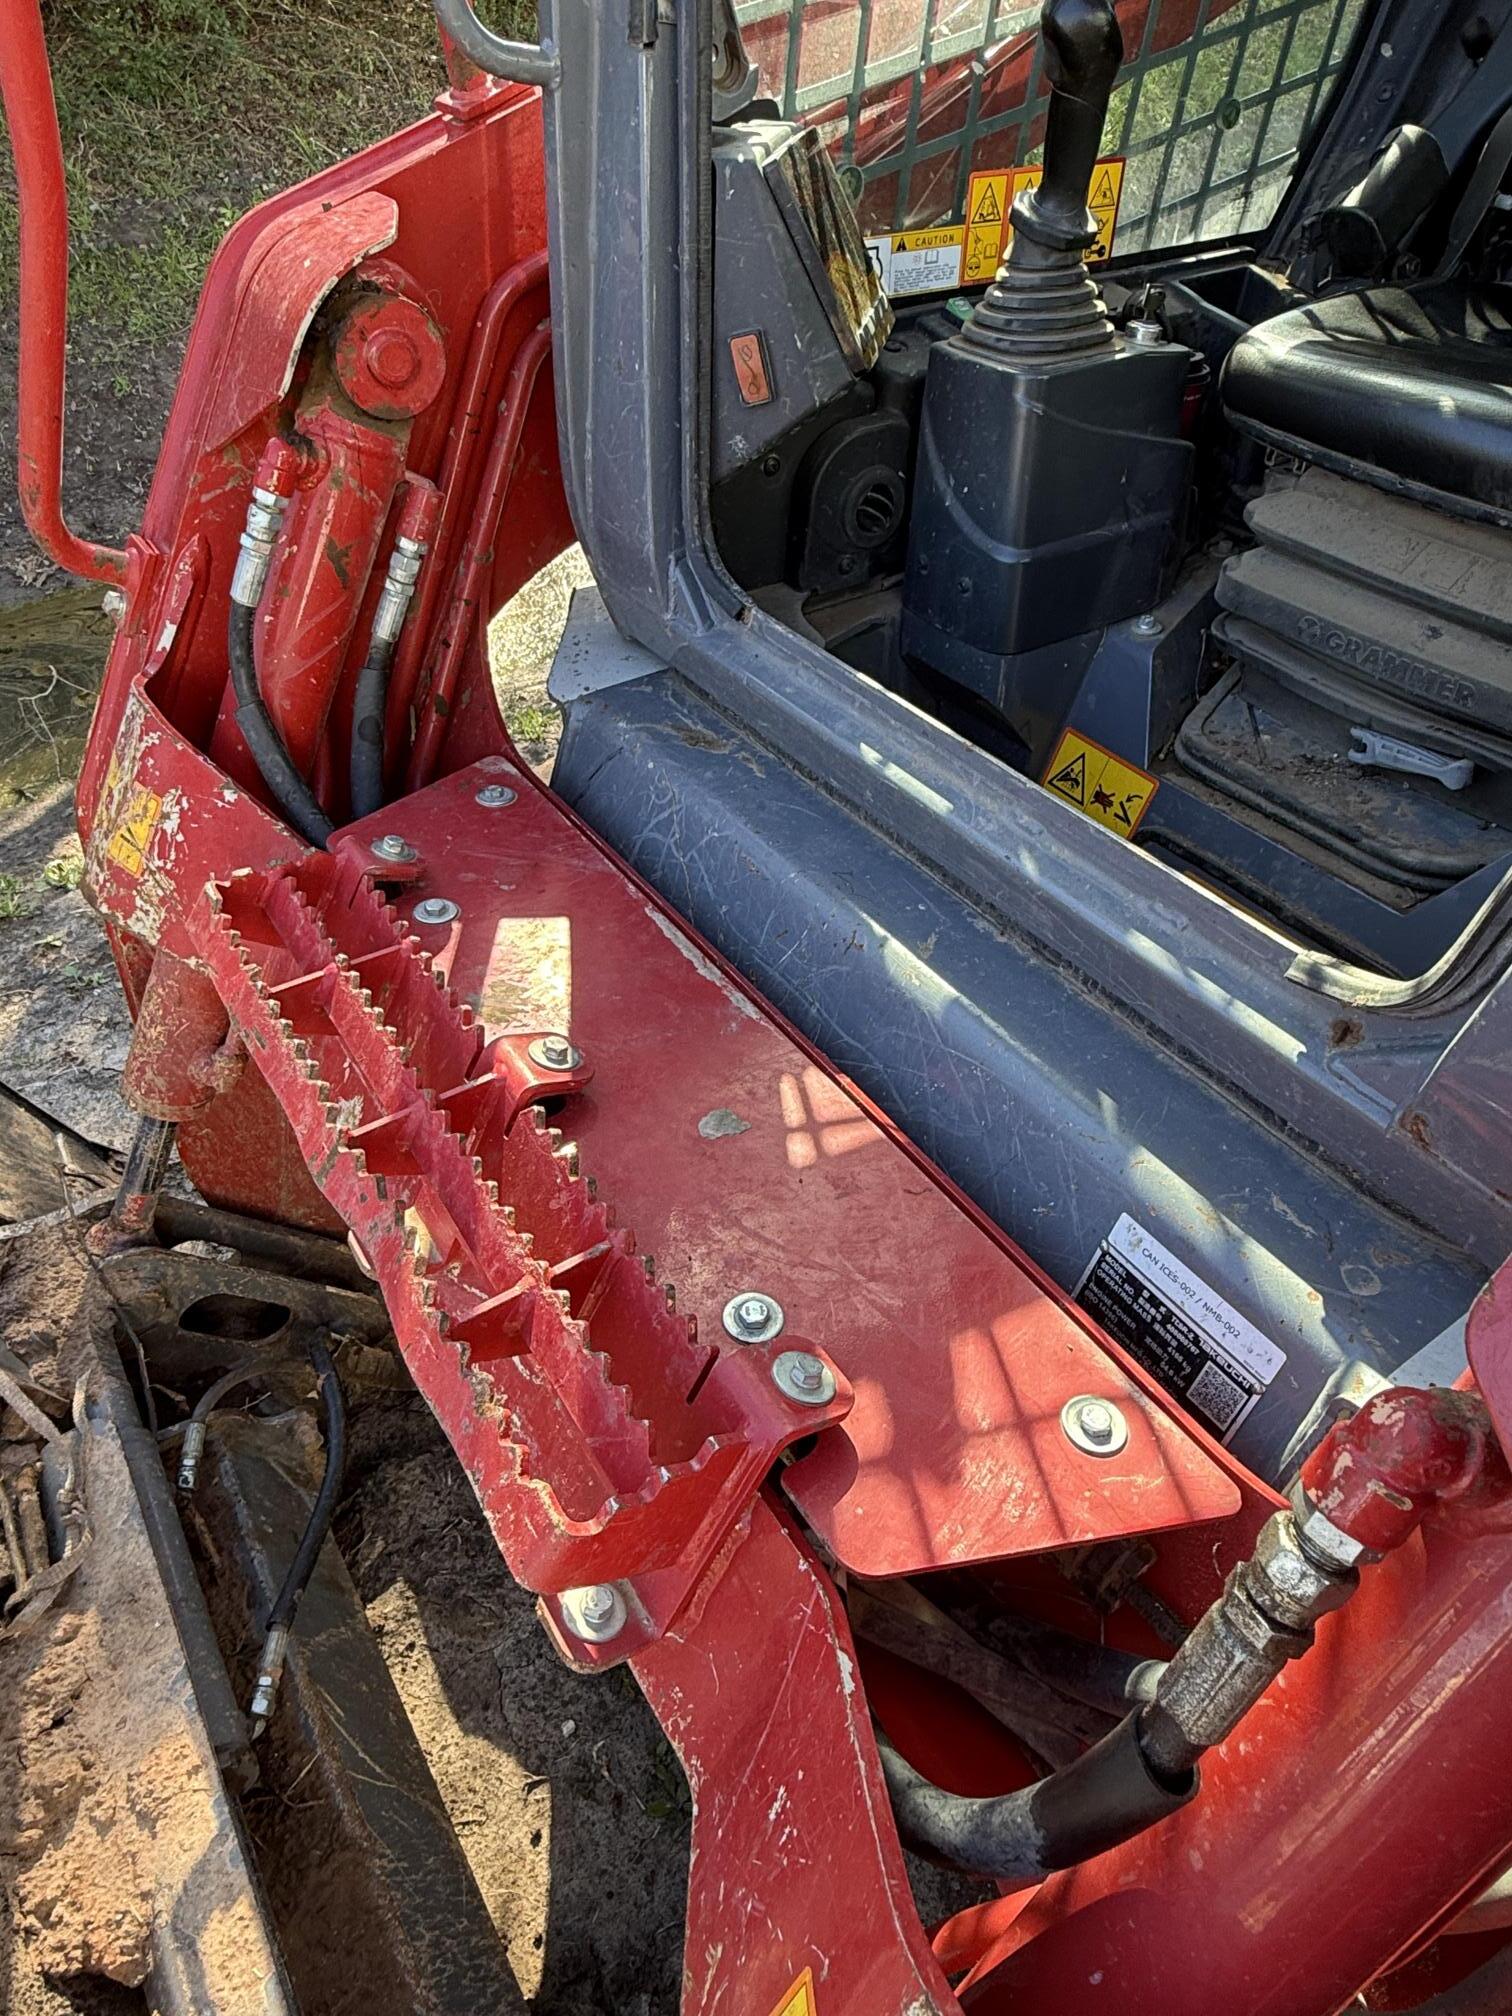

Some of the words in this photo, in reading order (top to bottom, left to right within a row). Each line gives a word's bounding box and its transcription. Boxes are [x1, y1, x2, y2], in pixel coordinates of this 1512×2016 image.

[914, 234, 955, 247] CAUTION
[1324, 630, 1477, 709] GRAMMER
[1100, 1262, 1121, 1284] SERIAL
[1123, 1283, 1134, 1294] NO.
[1105, 1254, 1126, 1277] MODEL
[1088, 1282, 1112, 1306] ENGINE
[1112, 1304, 1136, 1328] POWER
[1097, 1269, 1132, 1304] OPERATING
[1132, 1302, 1151, 1322] MASS
[1141, 1247, 1159, 1265] CAN
[1159, 1263, 1195, 1298] ICES-002
[1202, 1302, 1240, 1338] NMB-002
[1173, 1375, 1185, 1387] kW
[1182, 1360, 1191, 1373] kg
